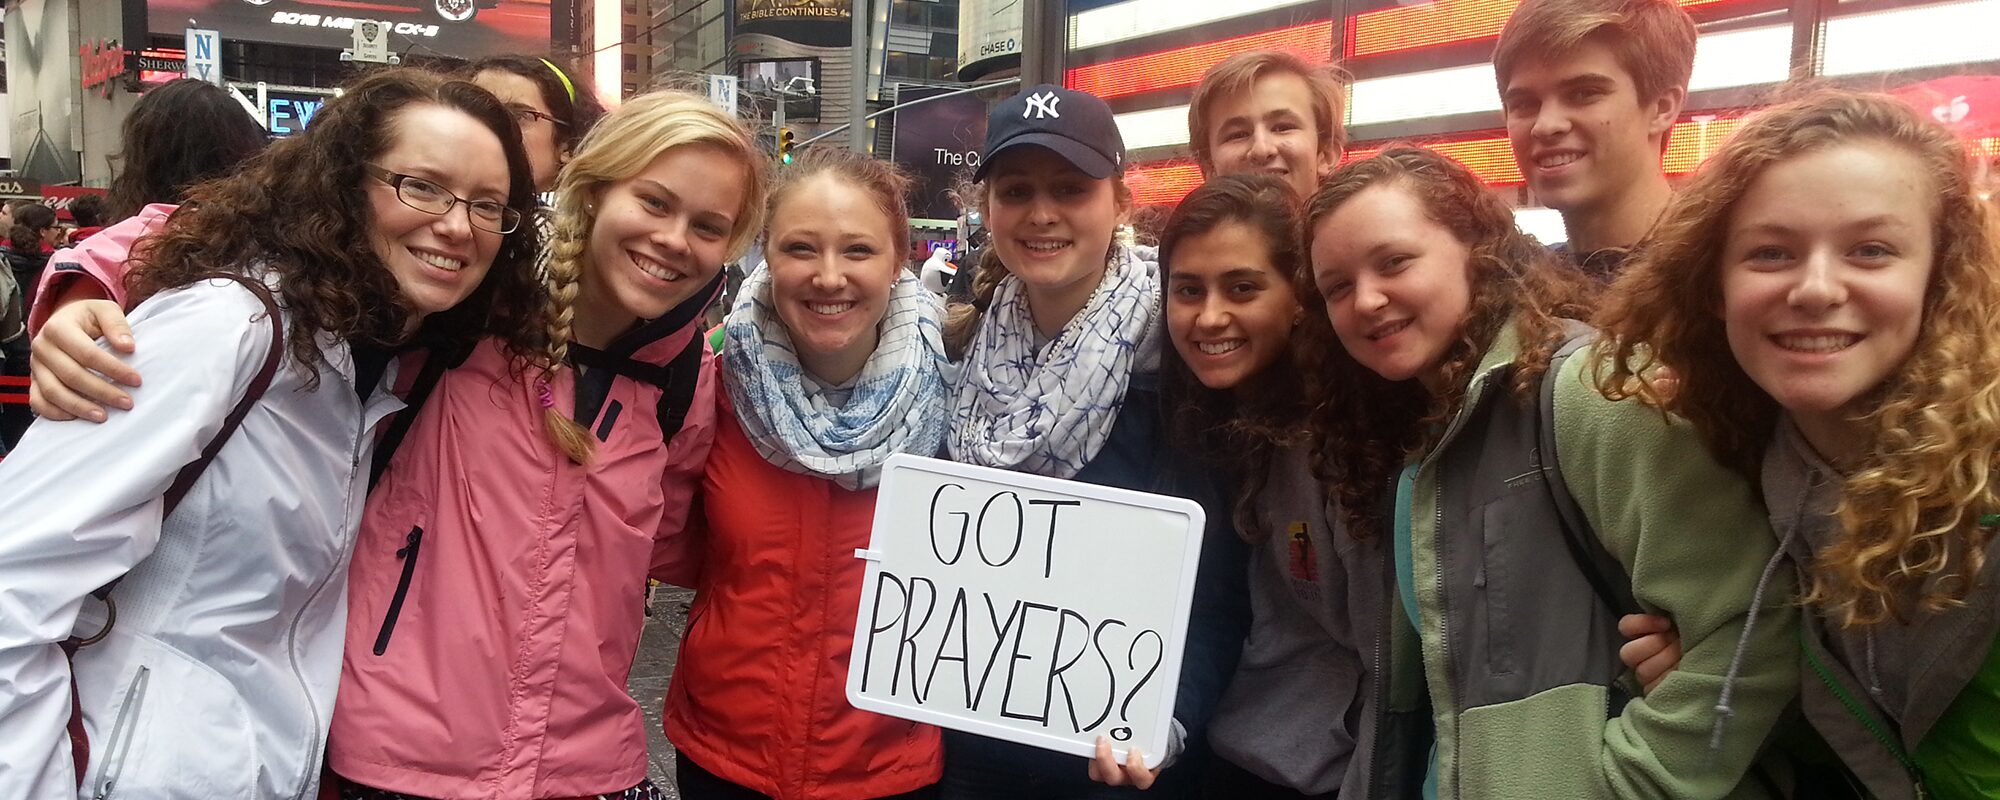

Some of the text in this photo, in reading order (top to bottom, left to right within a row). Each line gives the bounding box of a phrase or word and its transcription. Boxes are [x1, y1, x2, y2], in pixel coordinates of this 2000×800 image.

[751, 9, 775, 19] BIBLE
[776, 7, 838, 16] CONTINUES
[980, 40, 1006, 57] CHASE
[1022, 90, 1061, 120] NY
[933, 148, 963, 167] The
[928, 482, 1081, 579] GOT
[861, 571, 1164, 742] PRAYERS?
